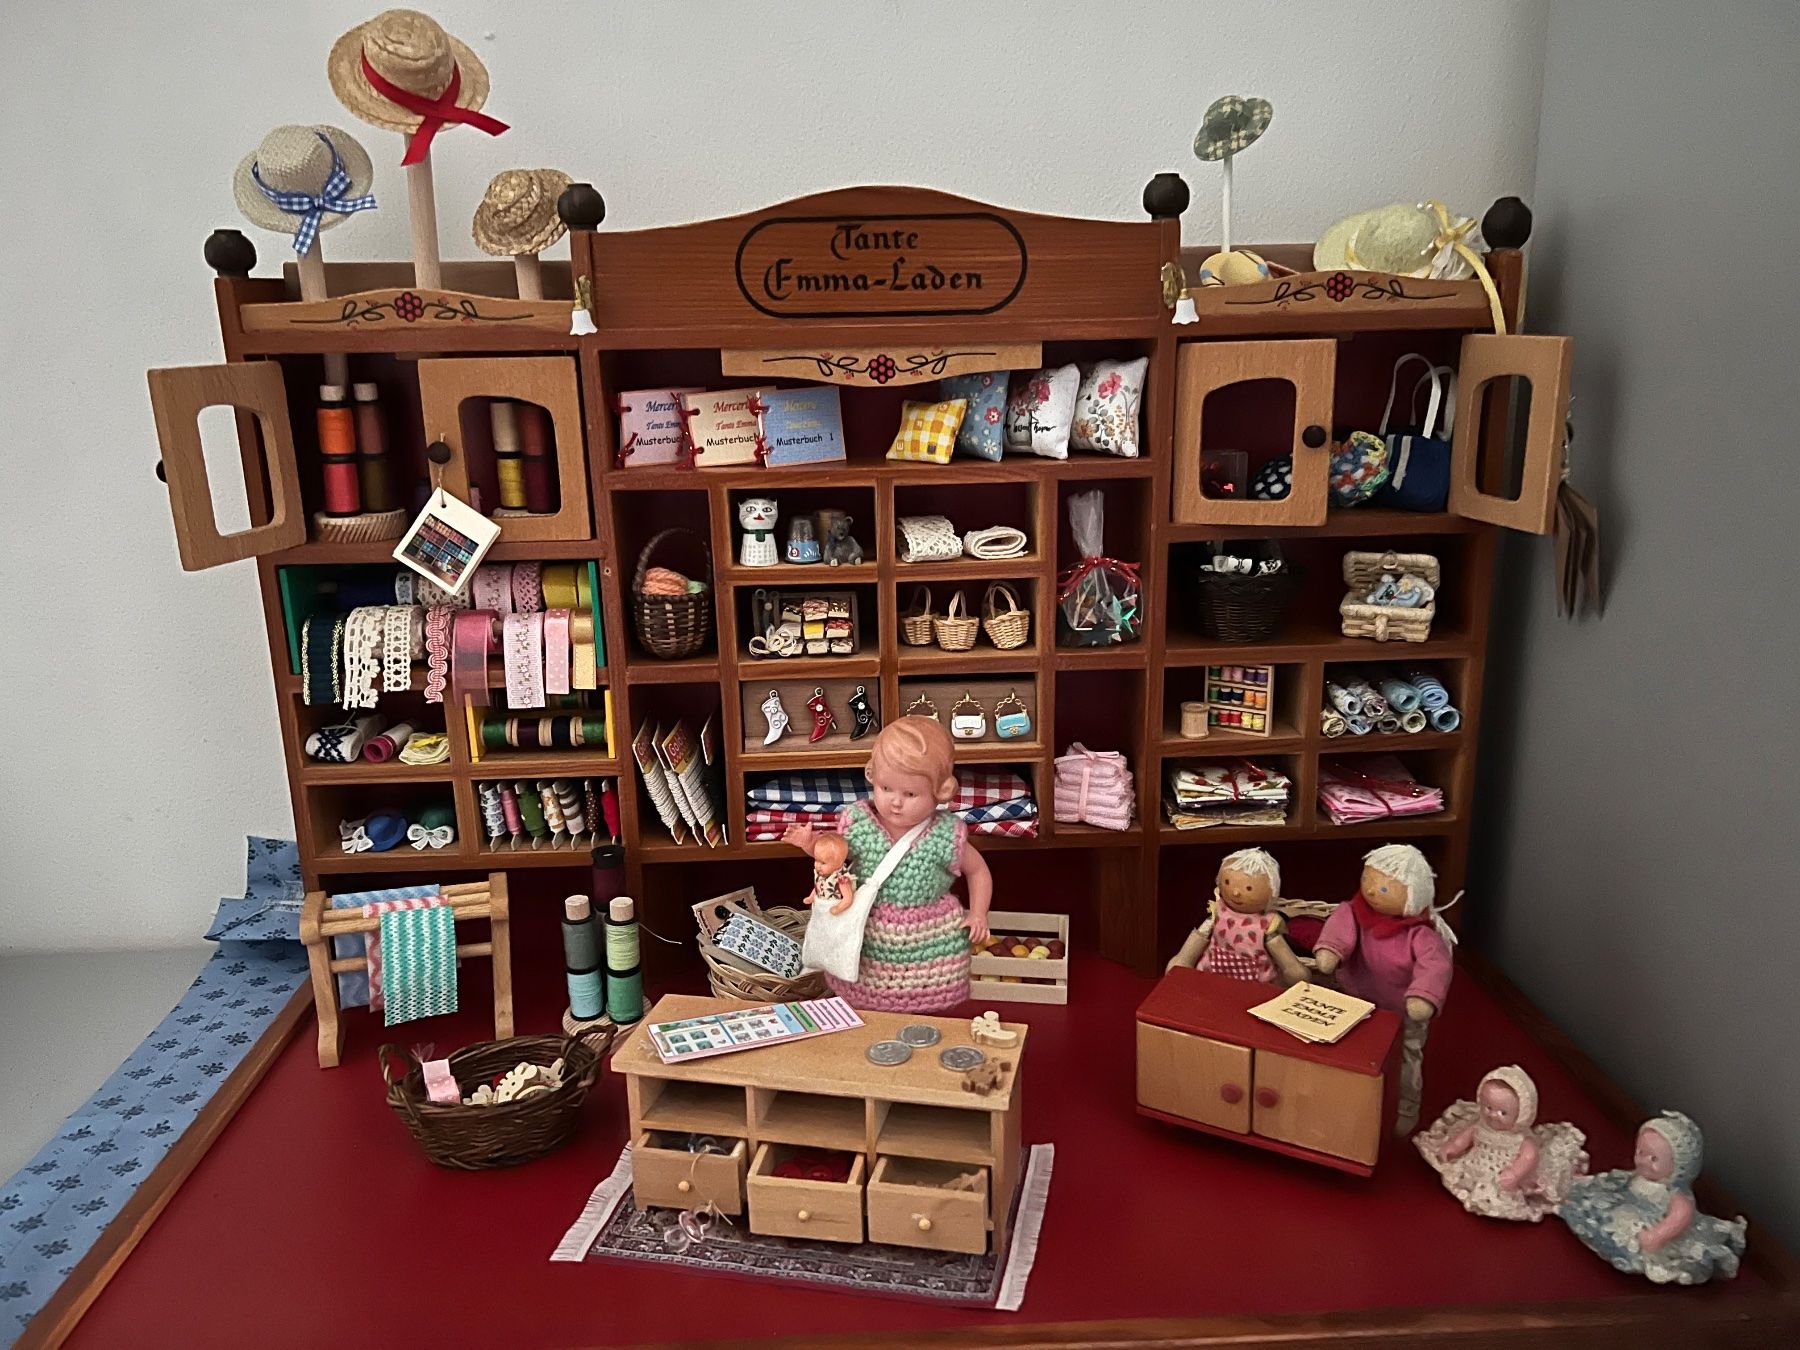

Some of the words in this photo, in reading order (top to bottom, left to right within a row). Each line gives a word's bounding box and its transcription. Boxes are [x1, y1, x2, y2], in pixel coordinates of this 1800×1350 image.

[830, 224, 919, 261] Tante
[763, 257, 983, 301] Emma-Laden
[645, 400, 676, 412] Mercer
[713, 401, 750, 413] Merceri
[665, 420, 681, 429] Emm
[636, 435, 681, 446] Musterbuc
[776, 433, 823, 447] Musterbuch
[829, 432, 834, 441] 1
[1291, 1002, 1337, 1020] EMMA
[1299, 996, 1348, 1015] TANTE
[1281, 1007, 1336, 1027] LADEN
